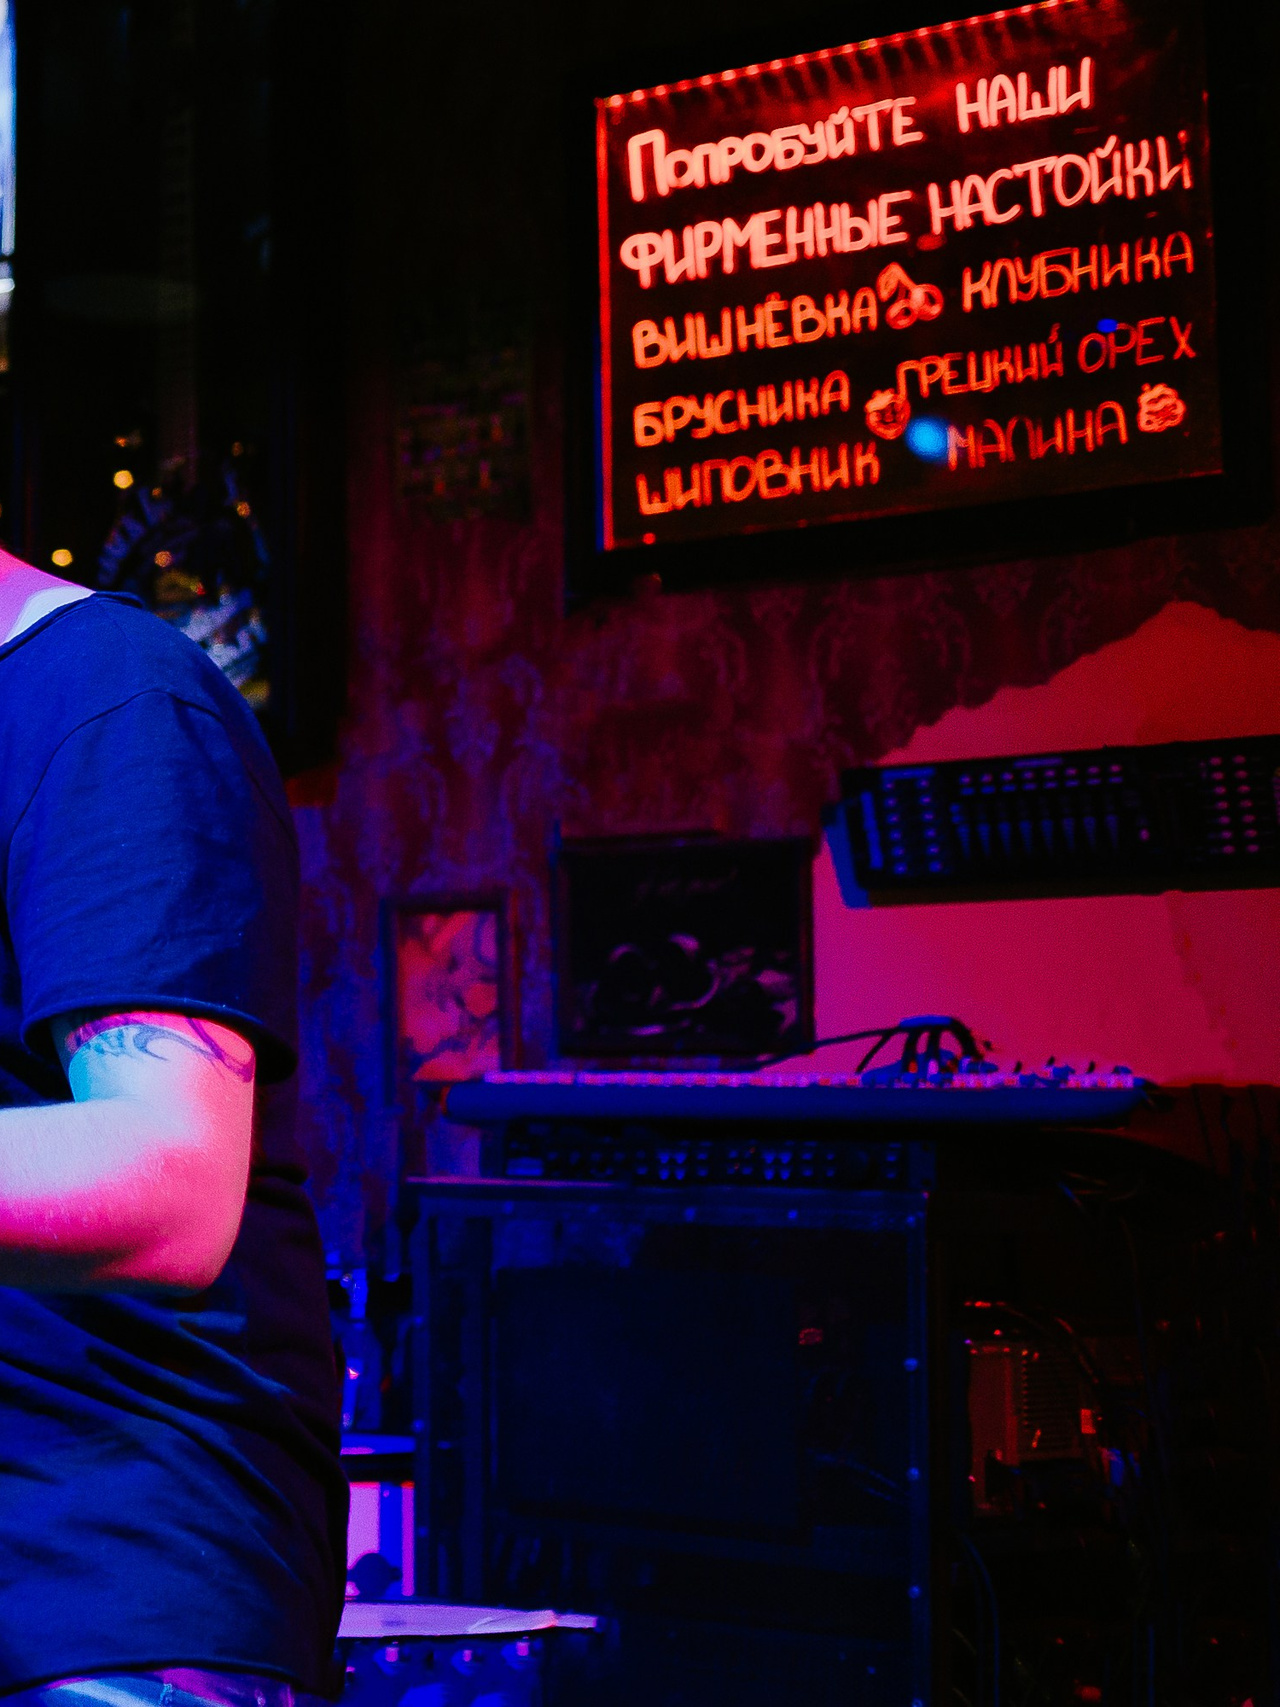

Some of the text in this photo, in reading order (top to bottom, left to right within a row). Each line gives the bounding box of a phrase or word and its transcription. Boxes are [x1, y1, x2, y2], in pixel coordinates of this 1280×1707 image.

[955, 56, 1093, 134] НАШИ
[619, 129, 1193, 289] ФИРМЕННЫЕ НАСТОЙКИ
[962, 230, 1195, 313] КЛУБНИКА
[895, 315, 1197, 401] ГРЕЦКИЙ ОРЕХ
[632, 369, 851, 447] БРУСНИКА
[946, 399, 1129, 471] МАЛИНА
[634, 441, 881, 516] ШИПОВНИК
